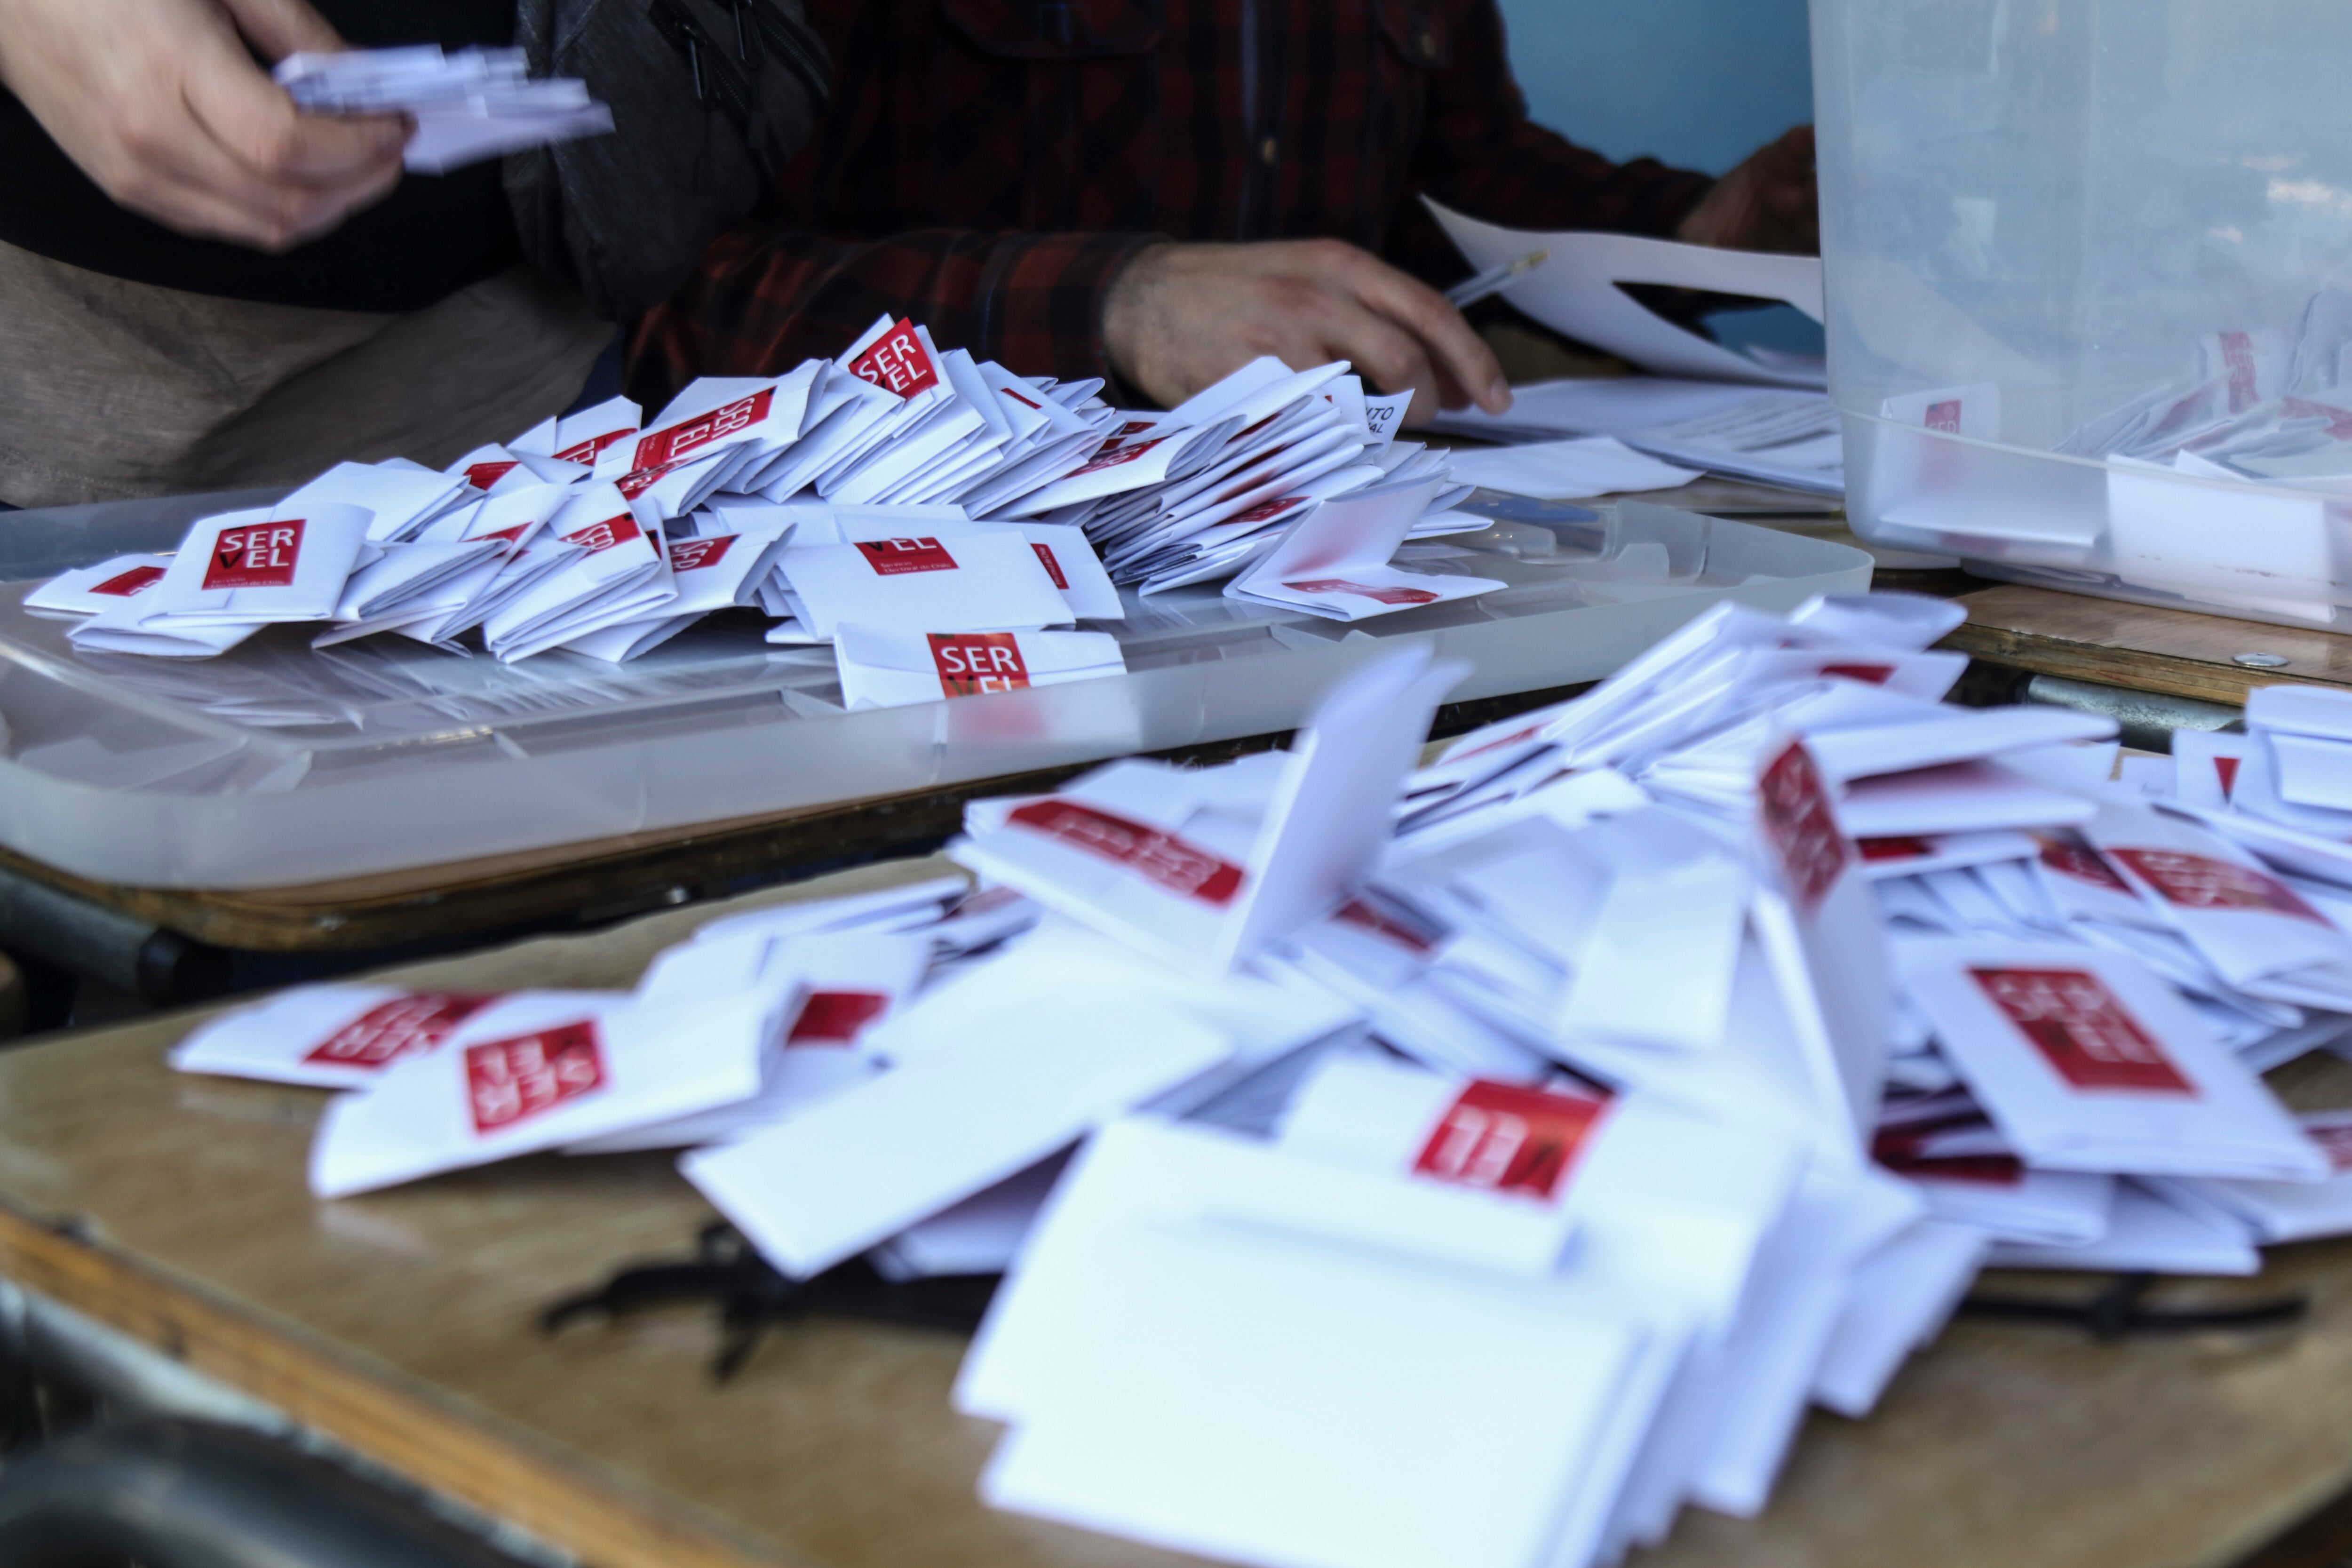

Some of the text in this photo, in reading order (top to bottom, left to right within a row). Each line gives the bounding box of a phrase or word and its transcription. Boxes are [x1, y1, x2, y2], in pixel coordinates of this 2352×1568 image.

[858, 334, 916, 384] SER
[712, 397, 755, 438] SER
[1366, 406, 1394, 420] ITO
[1368, 422, 1383, 433] AL
[220, 528, 295, 553] SER
[219, 548, 290, 569] VEL
[941, 646, 1019, 673] SER
